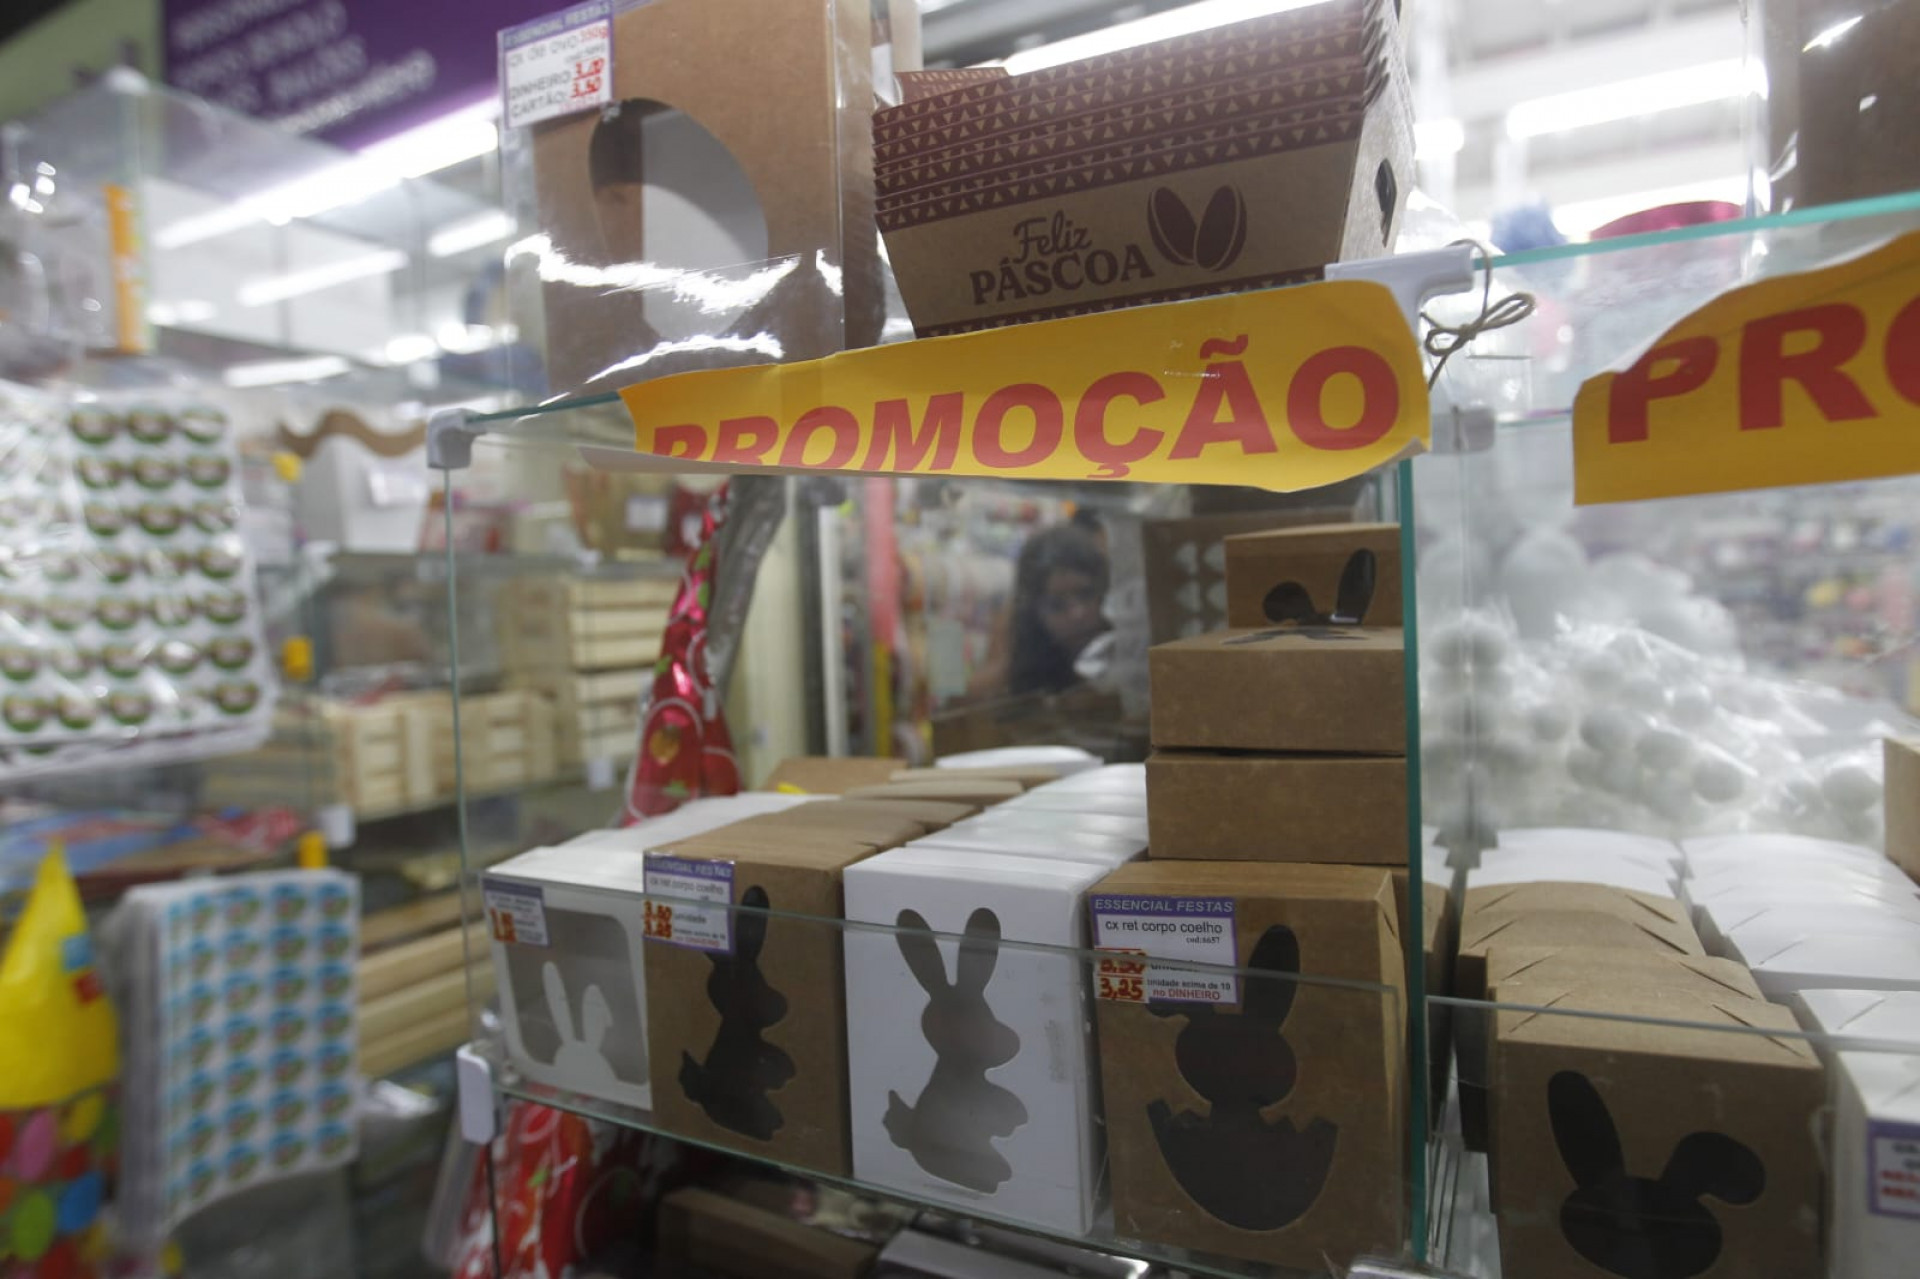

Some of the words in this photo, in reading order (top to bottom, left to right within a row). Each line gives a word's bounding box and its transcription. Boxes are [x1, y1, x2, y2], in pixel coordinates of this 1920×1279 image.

[1013, 209, 1092, 264] Feliz
[969, 244, 1155, 305] PÁSCOA
[1608, 295, 1920, 445] PR
[651, 334, 1400, 479] PROMOÇÃO
[1095, 899, 1172, 911] ESSENCIAL
[1176, 900, 1233, 912] FESTAS
[1105, 921, 1119, 931] cx
[1122, 921, 1139, 931] ret
[1142, 921, 1176, 936] corpo
[1180, 921, 1223, 934] coelho
[1100, 977, 1144, 1000] 3,25
[1153, 989, 1165, 997] no
[1168, 988, 1220, 1000] DINHEIRO
[1208, 982, 1218, 990] de
